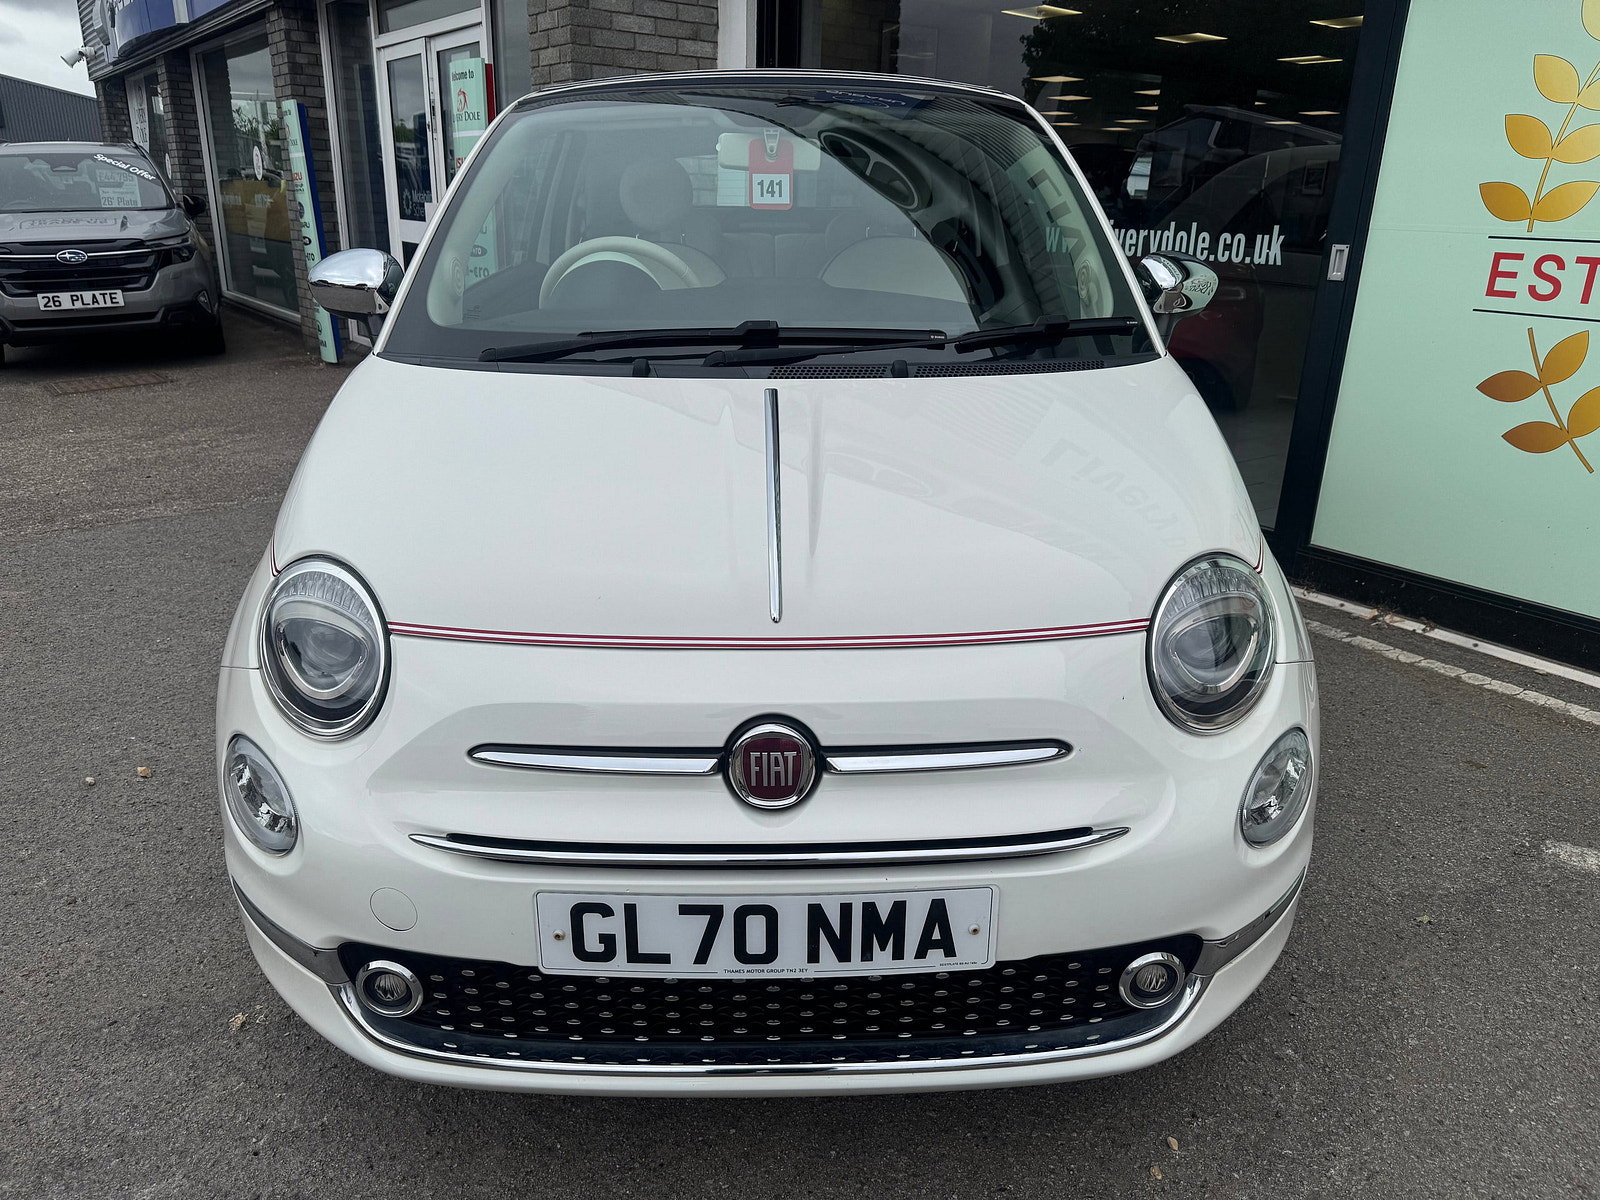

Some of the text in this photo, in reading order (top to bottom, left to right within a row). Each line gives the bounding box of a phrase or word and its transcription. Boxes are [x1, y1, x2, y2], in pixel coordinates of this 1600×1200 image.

[464, 111, 481, 121] DOLE
[93, 153, 156, 180] Special Offer
[757, 179, 783, 198] 141
[42, 292, 120, 308] 26 PLATE
[749, 751, 798, 787] FIAT
[570, 898, 957, 965] GL70 NMA
